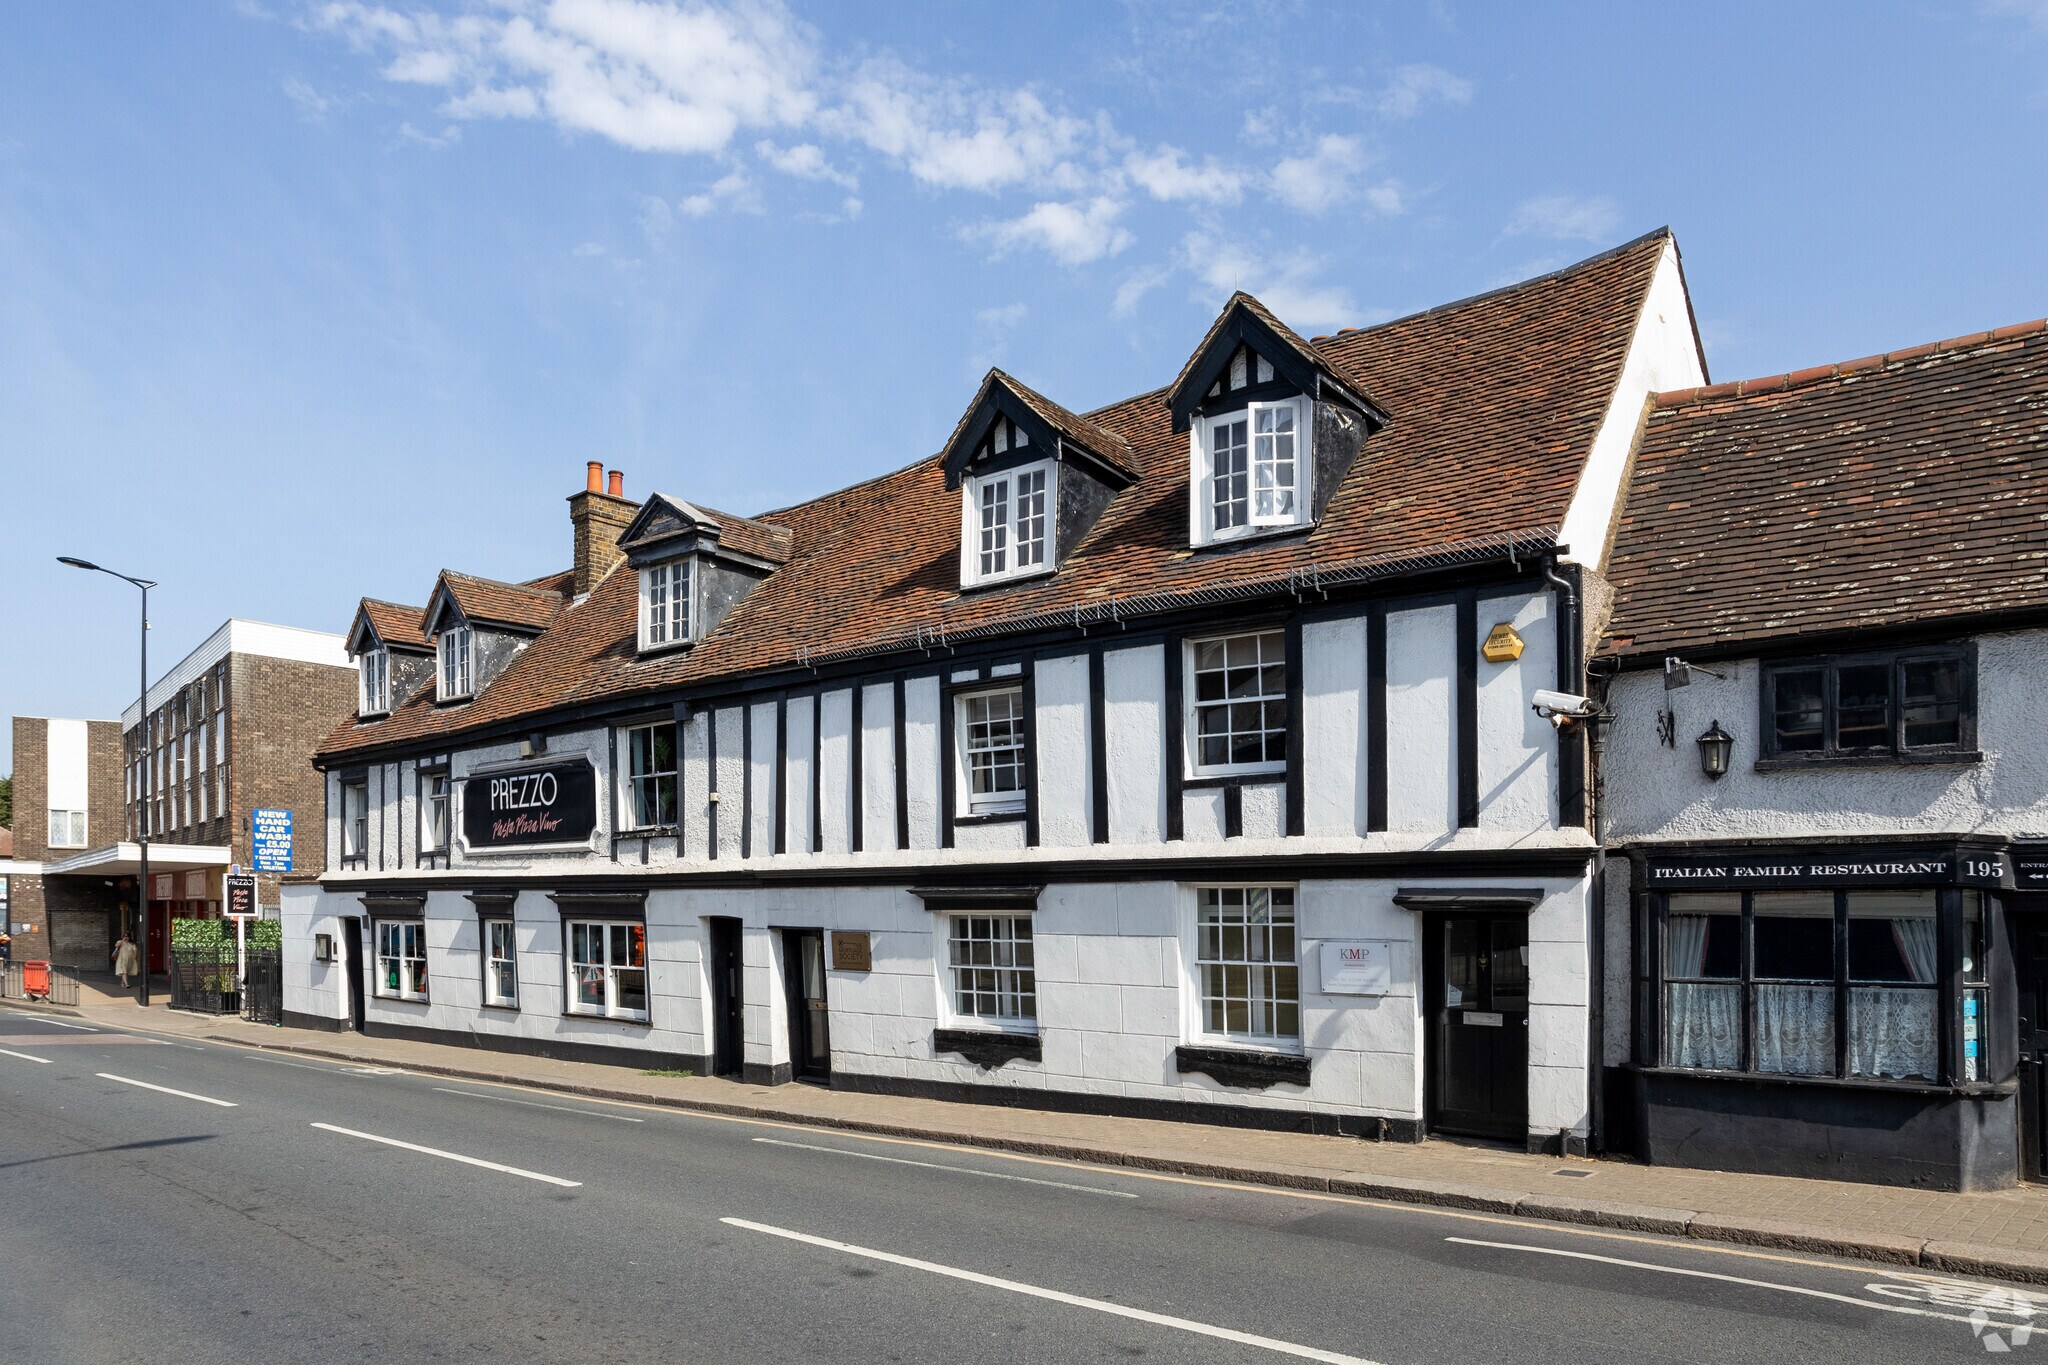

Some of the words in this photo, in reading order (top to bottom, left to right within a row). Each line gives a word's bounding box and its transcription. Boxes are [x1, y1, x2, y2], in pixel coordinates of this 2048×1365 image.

[491, 772, 557, 811] PREZZO
[258, 810, 287, 818] NEW
[255, 817, 291, 826] HAND
[492, 818, 515, 840] Pasta
[515, 813, 539, 836] Pizza
[539, 811, 563, 833] Vino
[259, 825, 285, 833] CAR
[254, 832, 291, 840] WASH
[266, 840, 290, 848] £5.00
[1654, 867, 1727, 878] ITALIAN
[1733, 866, 1803, 877] FAMILY
[1809, 863, 1946, 876] RESTAURANT
[1966, 861, 2004, 877] 195
[228, 878, 253, 886] PREZZO
[1340, 949, 1370, 959] KMP
